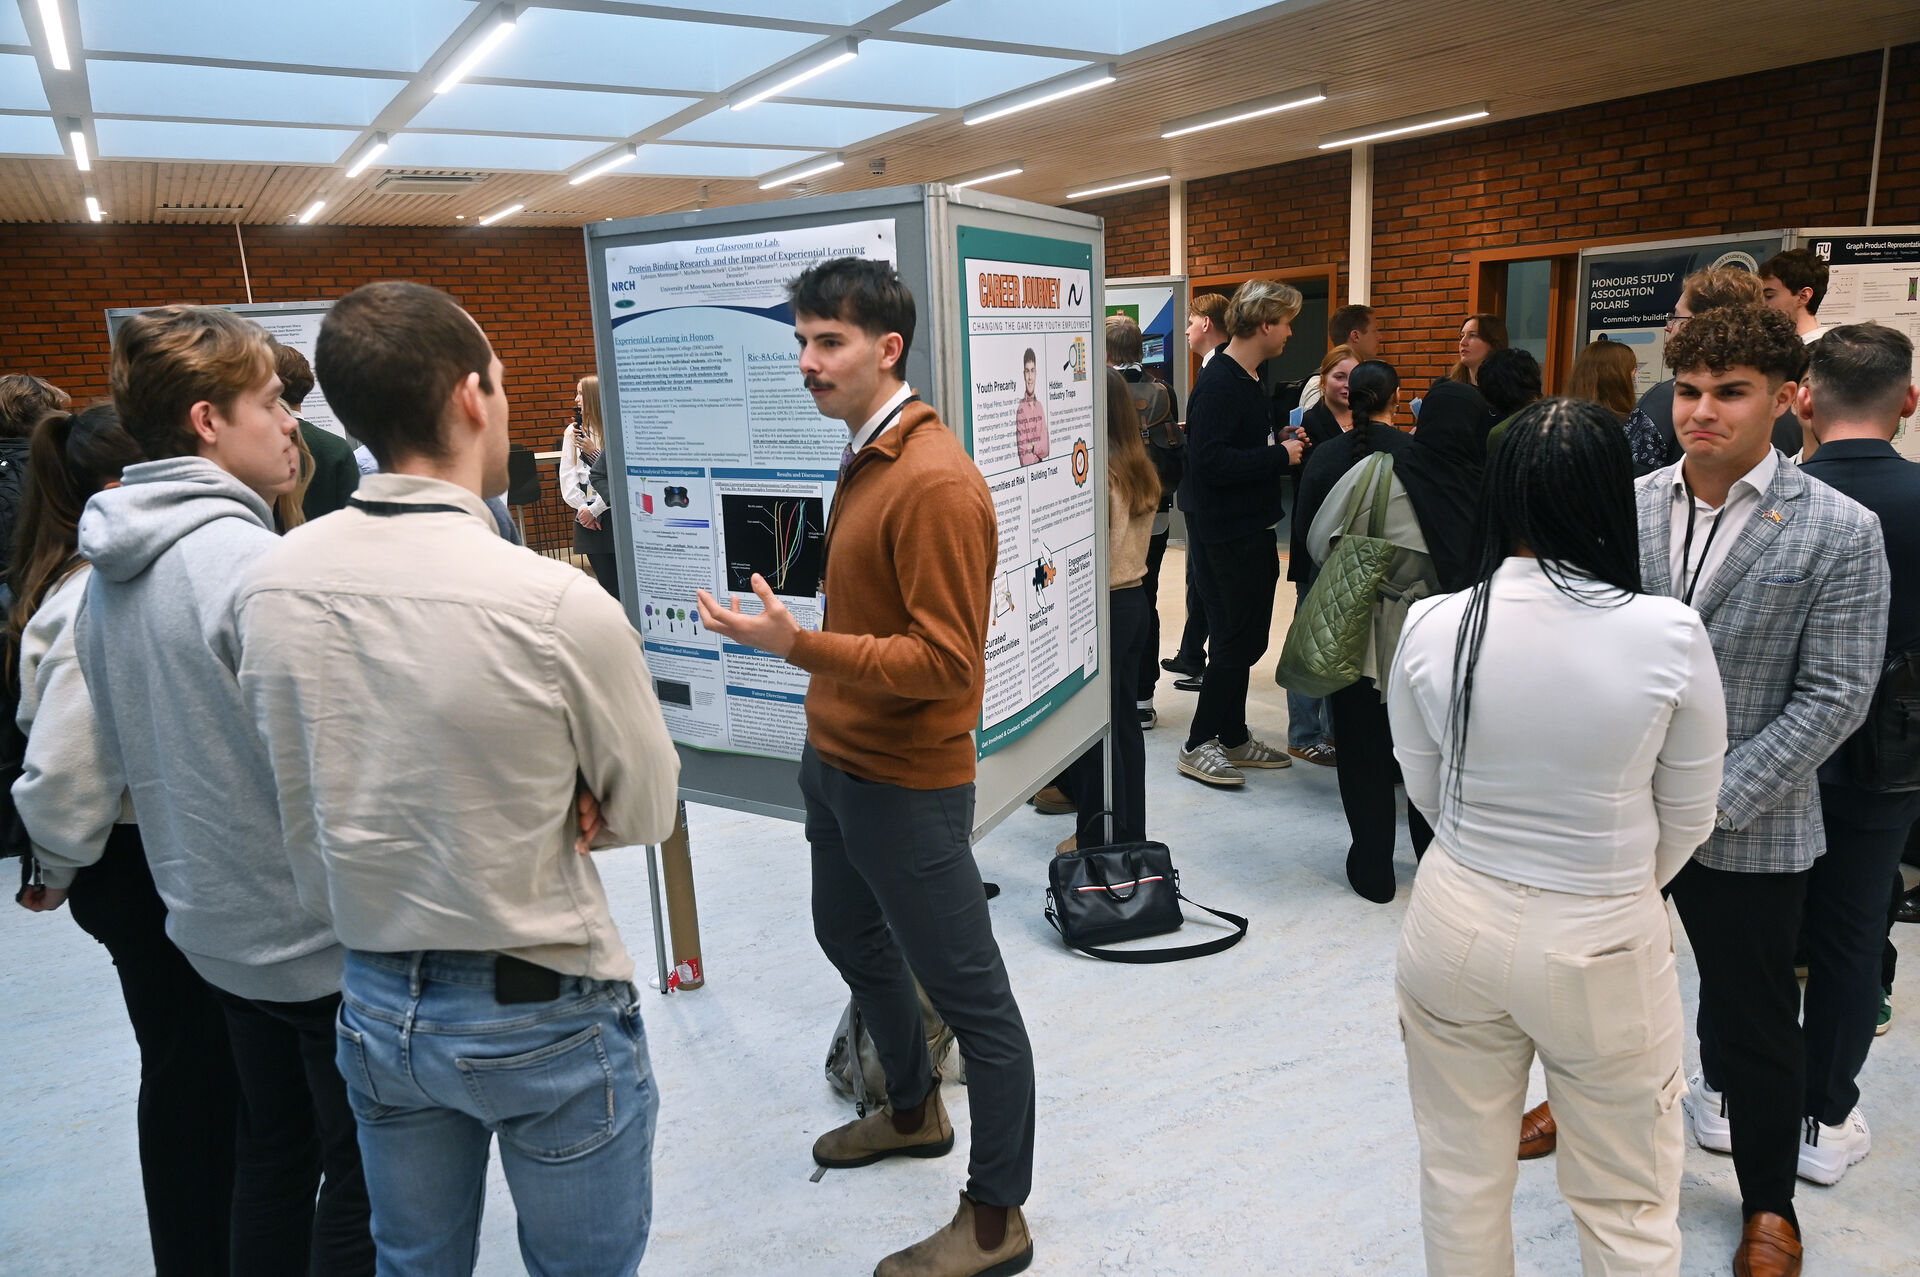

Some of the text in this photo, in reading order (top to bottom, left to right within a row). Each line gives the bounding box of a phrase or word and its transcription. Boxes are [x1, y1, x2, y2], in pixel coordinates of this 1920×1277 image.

[695, 245, 715, 255] From
[716, 241, 754, 252] Classroom
[755, 241, 763, 249] to
[1845, 242, 1864, 251] Graph
[629, 244, 866, 274] Protein Binding Research and the Impact of Experiential Learning
[612, 280, 636, 292] NRCH
[660, 285, 684, 293] University
[712, 281, 736, 289] Northern
[736, 279, 755, 287] Rockies
[1592, 273, 1675, 288] HONOURS STUDY
[979, 272, 1061, 309] CAREER JOURNEY
[1591, 286, 1655, 300] ASSOCIATION
[1591, 299, 1630, 311] POLARIS
[972, 320, 1090, 331] CHANGING THE GAME FOR YOUTH EMPLOYMENT
[1602, 315, 1641, 324] Community
[614, 333, 715, 347] Experiential Learning in Honors
[976, 380, 1017, 394] Youth Precarity
[1049, 380, 1063, 390] Hidden
[1049, 389, 1076, 401] Industry Traps
[1030, 466, 1058, 481] Building Trust
[1016, 476, 1025, 486] Risk
[1068, 552, 1088, 568] Engagement
[1068, 560, 1091, 577] Global Vision
[1029, 603, 1055, 622] Smart Career
[1029, 617, 1048, 633] Matching
[985, 632, 1007, 650] Curated
[985, 638, 1020, 662] Opportunities
[766, 692, 788, 700] Directions
[988, 732, 1004, 745] Involved
